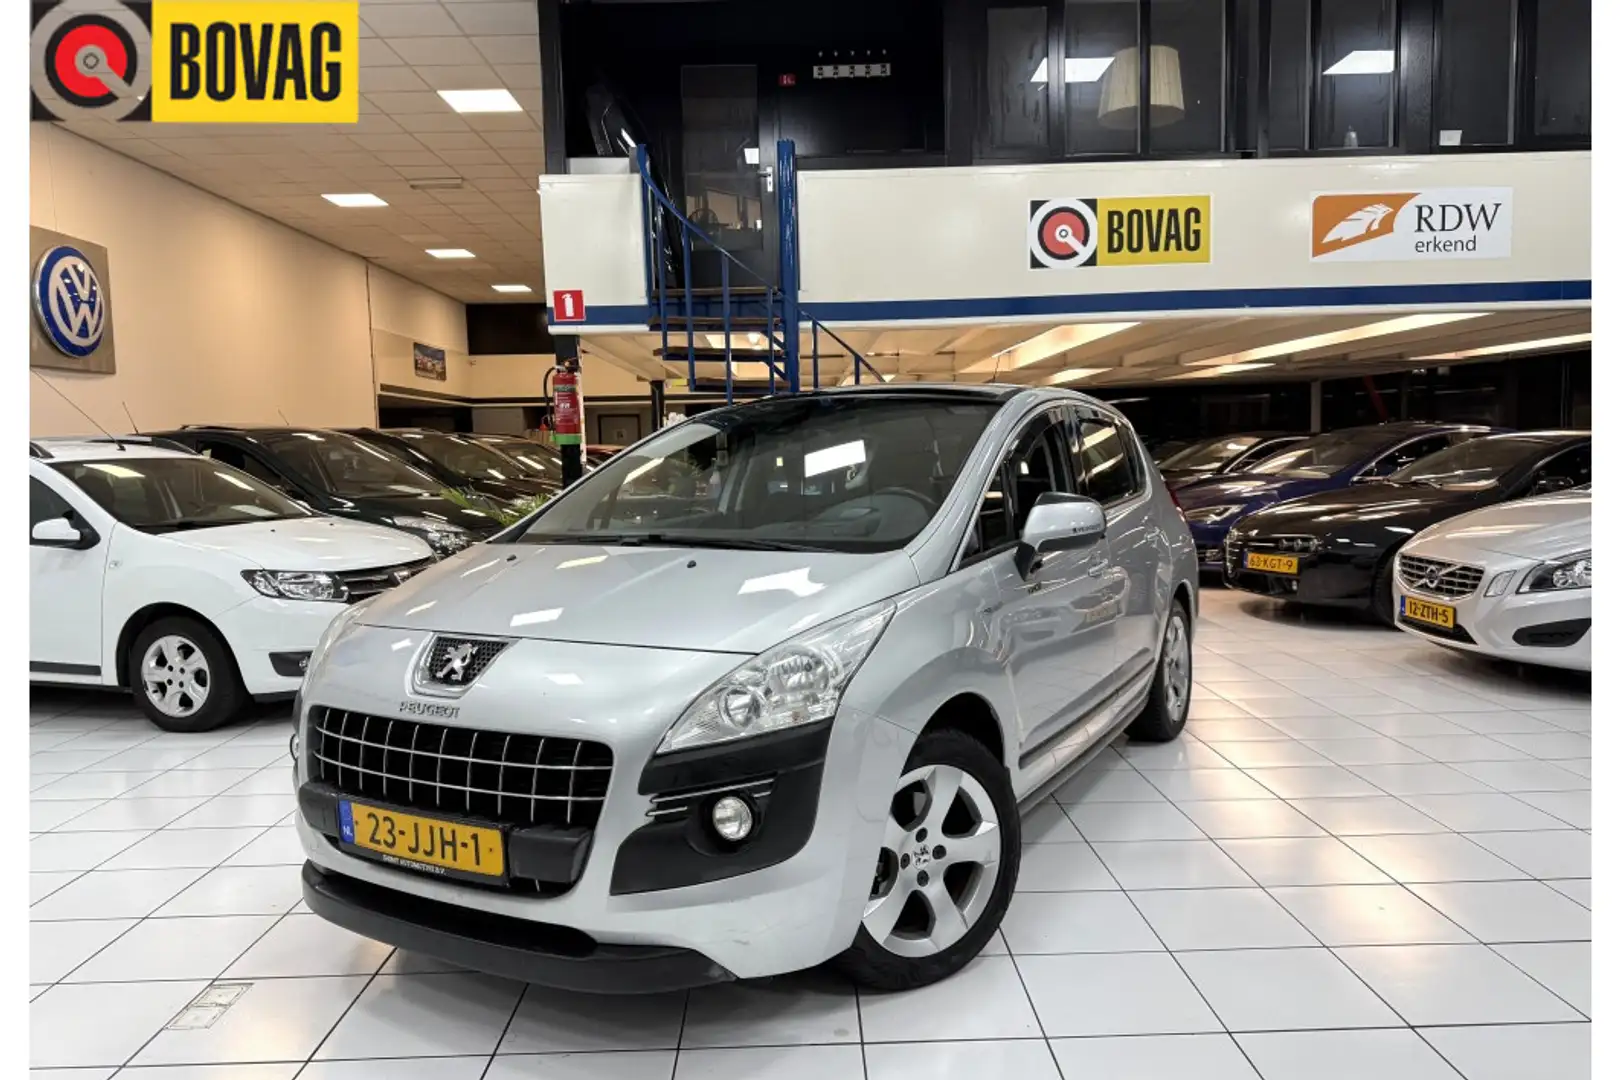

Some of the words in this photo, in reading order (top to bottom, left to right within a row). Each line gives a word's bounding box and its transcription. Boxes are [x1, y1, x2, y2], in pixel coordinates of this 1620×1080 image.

[1414, 203, 1502, 232] RDW
[1107, 207, 1201, 254] BOVAG
[1414, 235, 1477, 253] erkend
[1409, 600, 1449, 624] 12-ZTH-5
[399, 701, 461, 719] PEUGEOT
[342, 824, 354, 837] NL
[366, 811, 481, 867] 23-JJH-1
